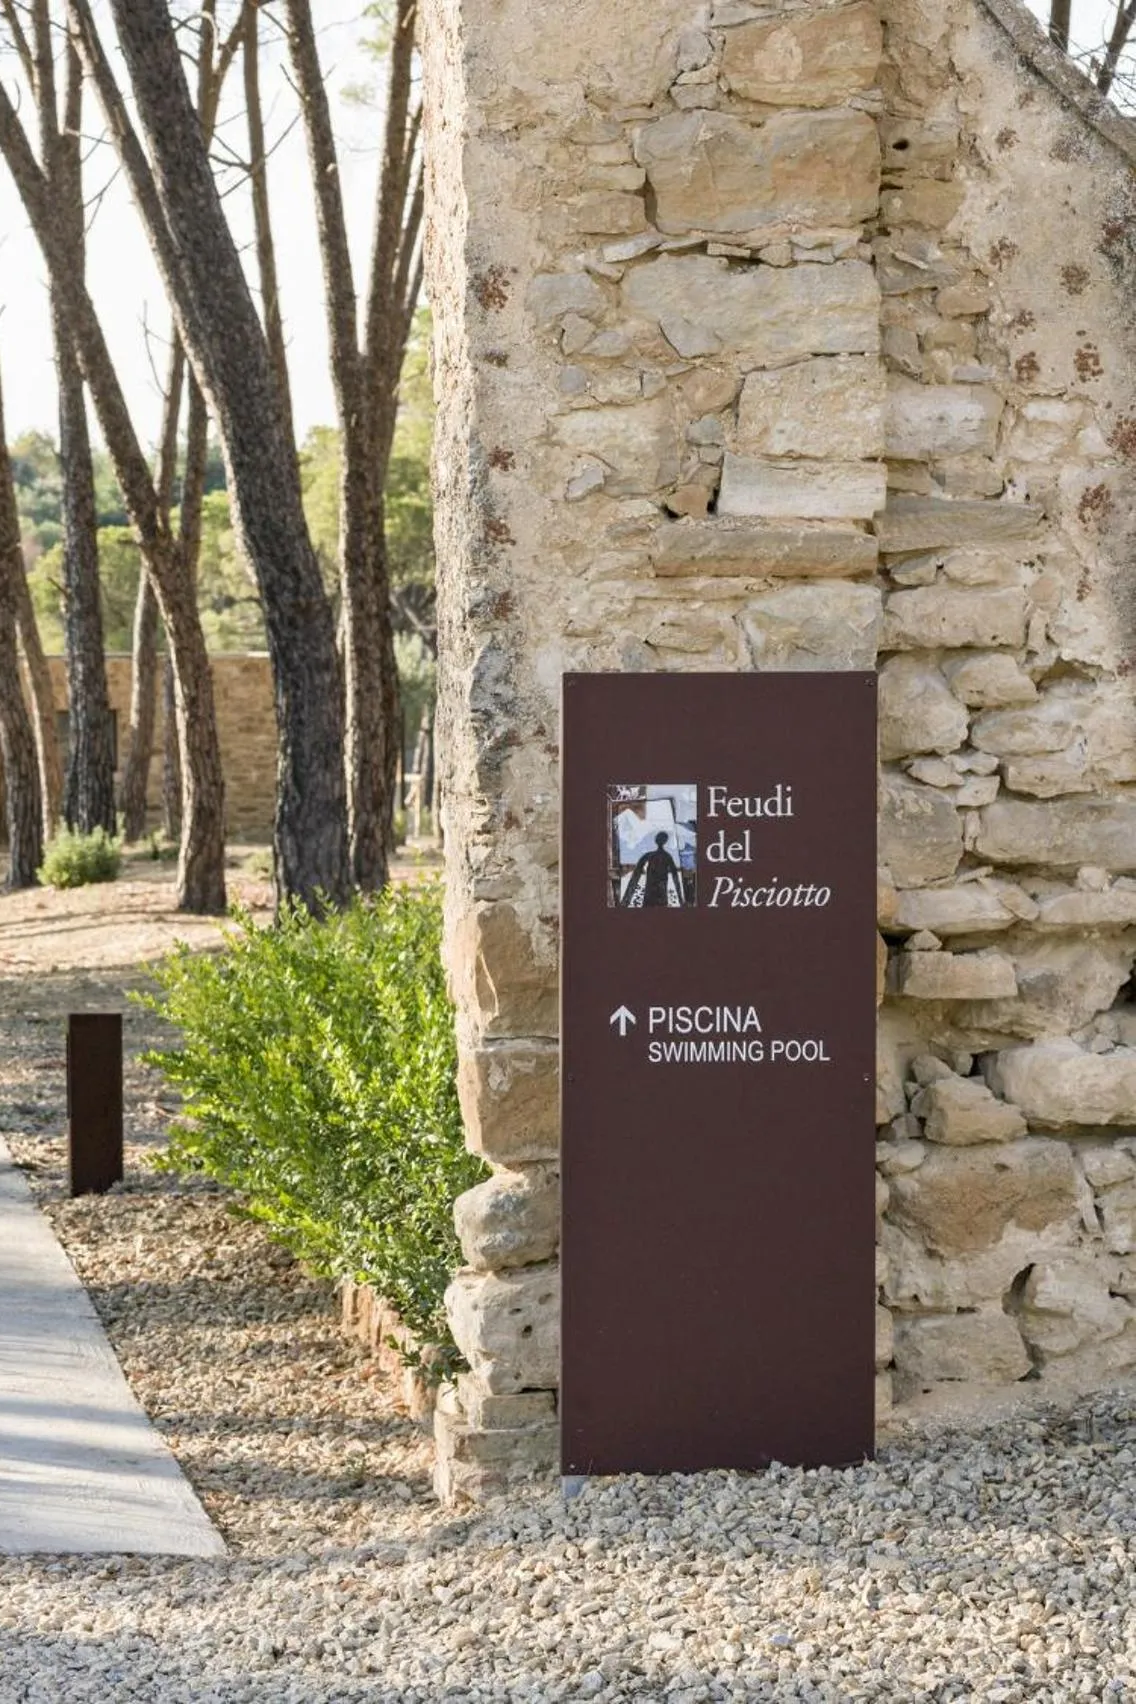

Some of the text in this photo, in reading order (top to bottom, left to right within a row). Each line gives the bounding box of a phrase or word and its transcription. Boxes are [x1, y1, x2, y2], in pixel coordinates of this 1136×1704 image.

[707, 784, 793, 817] Feudi
[706, 830, 752, 862] del
[708, 876, 831, 907] Pisciotto
[649, 1006, 762, 1033] PISCINA
[648, 1040, 830, 1062] SWIMMING POOL
